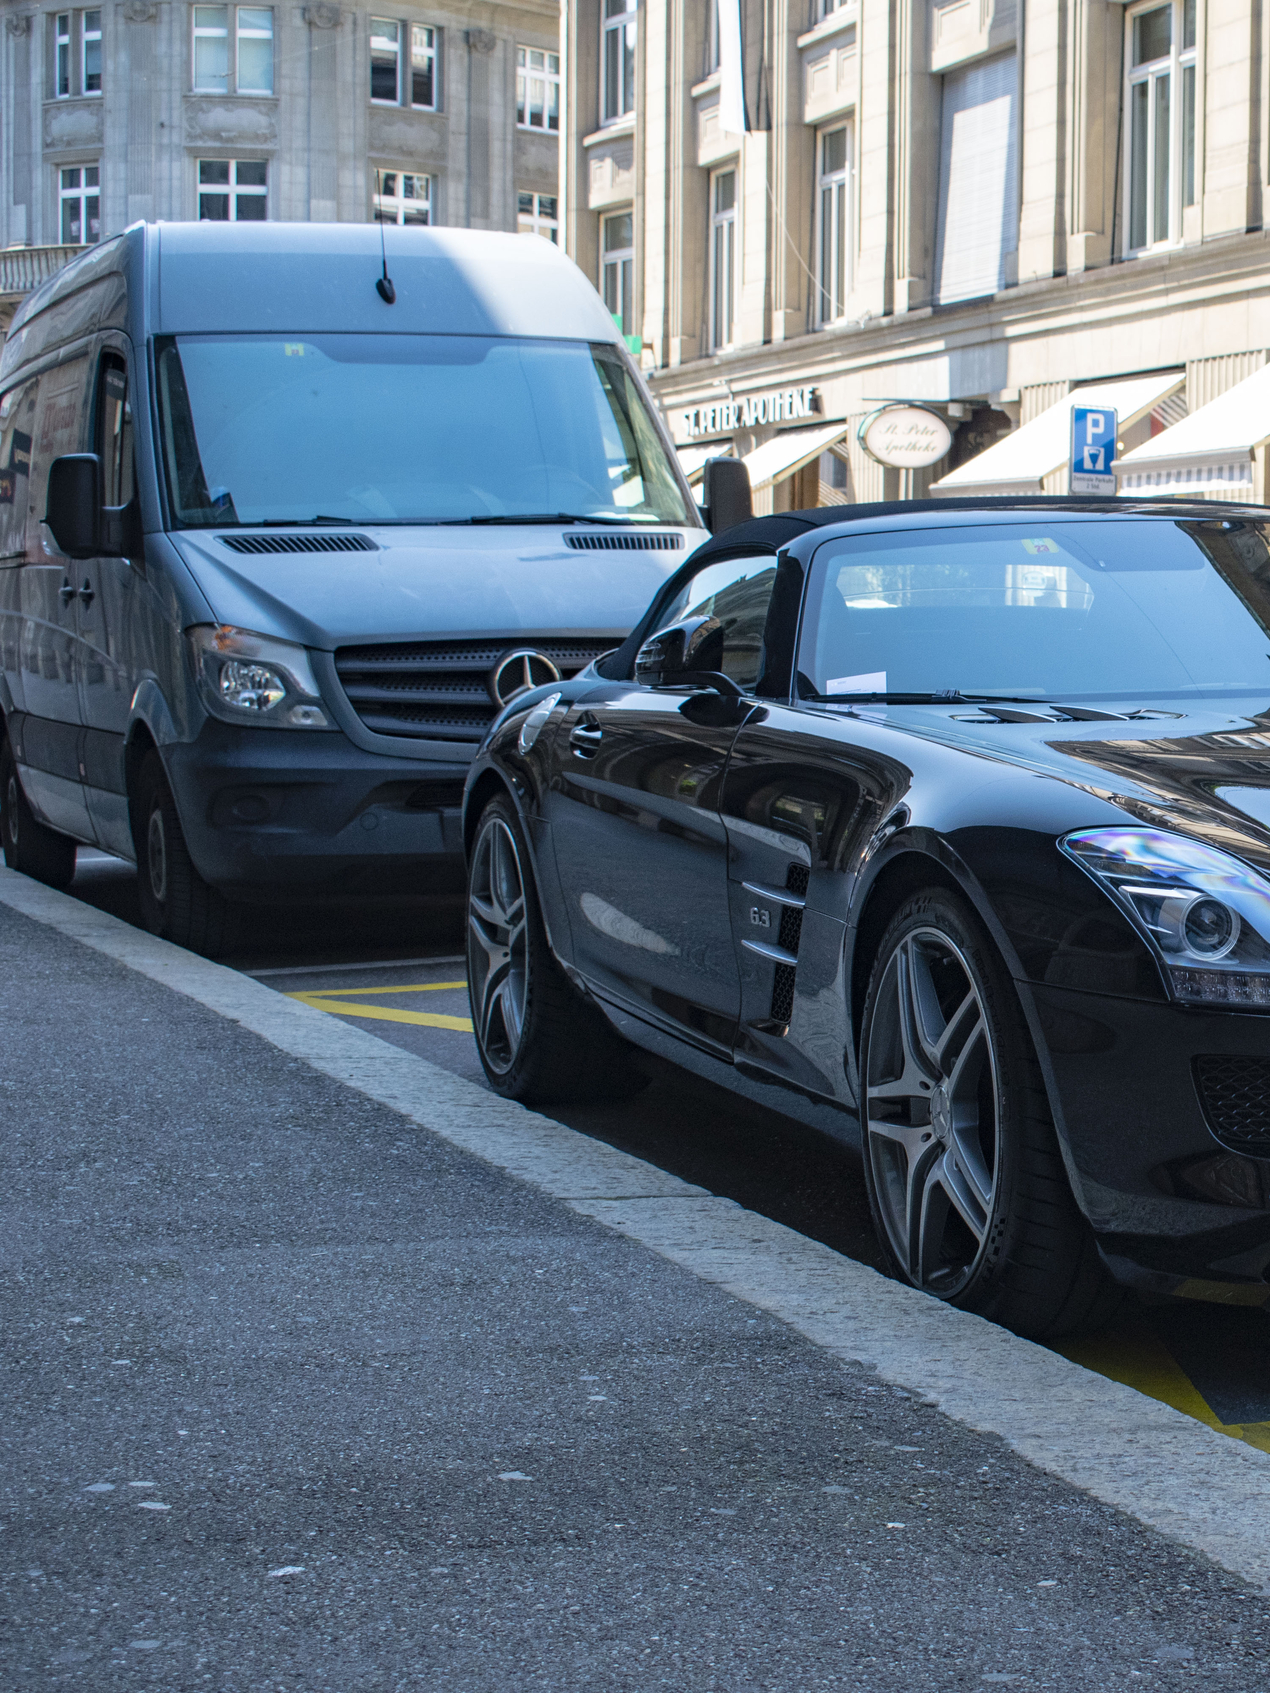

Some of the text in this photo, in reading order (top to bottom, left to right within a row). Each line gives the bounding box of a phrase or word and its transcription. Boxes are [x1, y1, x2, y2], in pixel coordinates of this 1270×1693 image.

[699, 400, 739, 434] PETER
[741, 386, 814, 428] APOTHEKE
[1086, 412, 1105, 445] P
[750, 907, 770, 928] 63
